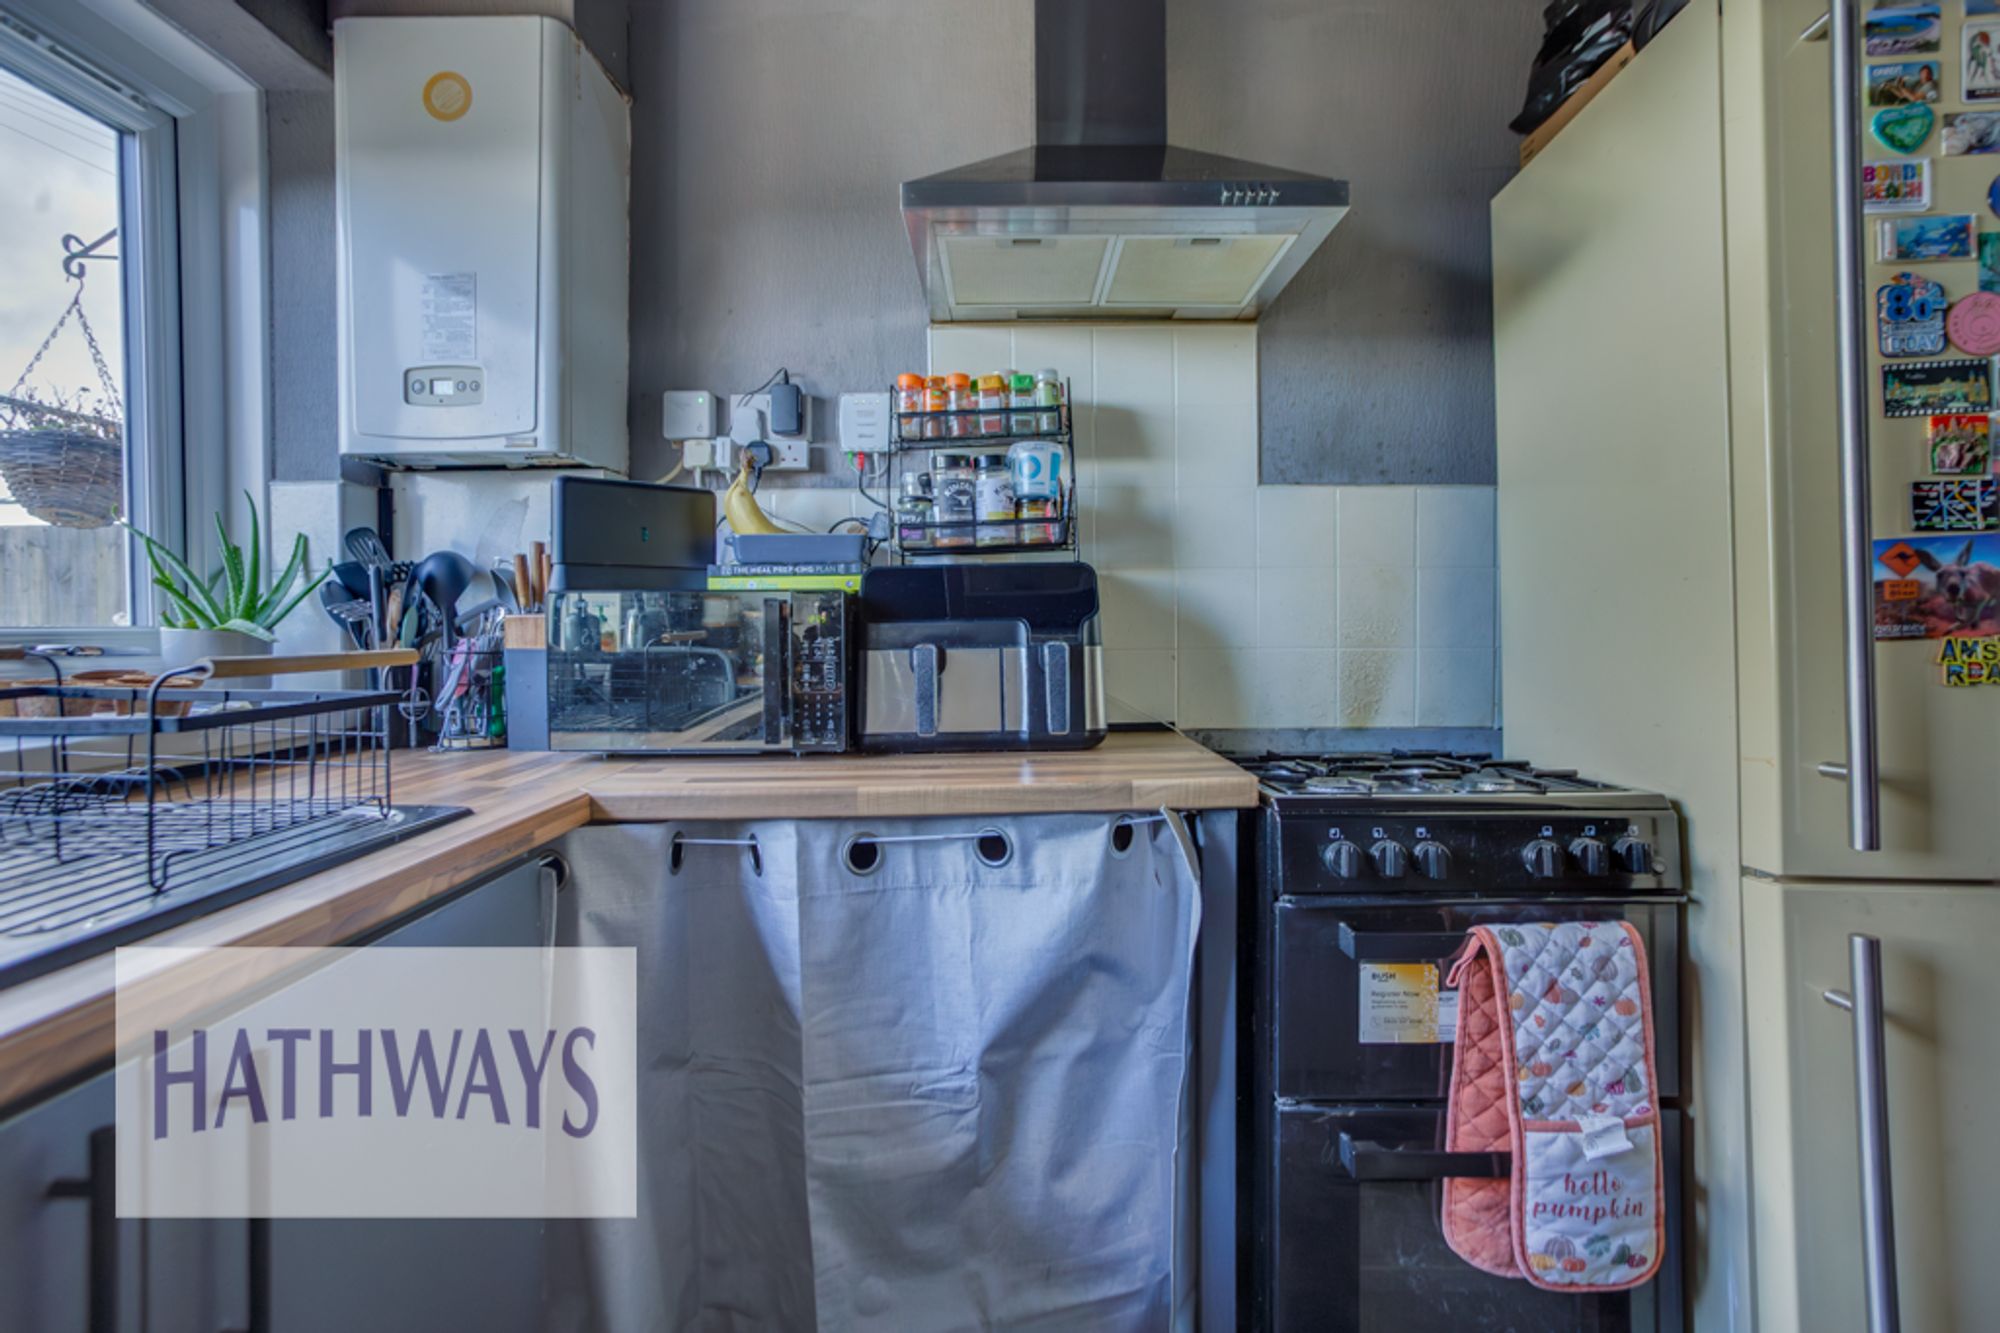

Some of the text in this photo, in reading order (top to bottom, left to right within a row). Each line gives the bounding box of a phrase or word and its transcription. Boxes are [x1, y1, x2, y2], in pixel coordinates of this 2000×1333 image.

[751, 566, 771, 574] MEAL
[815, 565, 837, 574] PLAN
[1941, 637, 2000, 662] AMS
[1371, 972, 1397, 980] BUSH
[1564, 1170, 1624, 1196] hello
[1532, 1197, 1643, 1225] pumpkin
